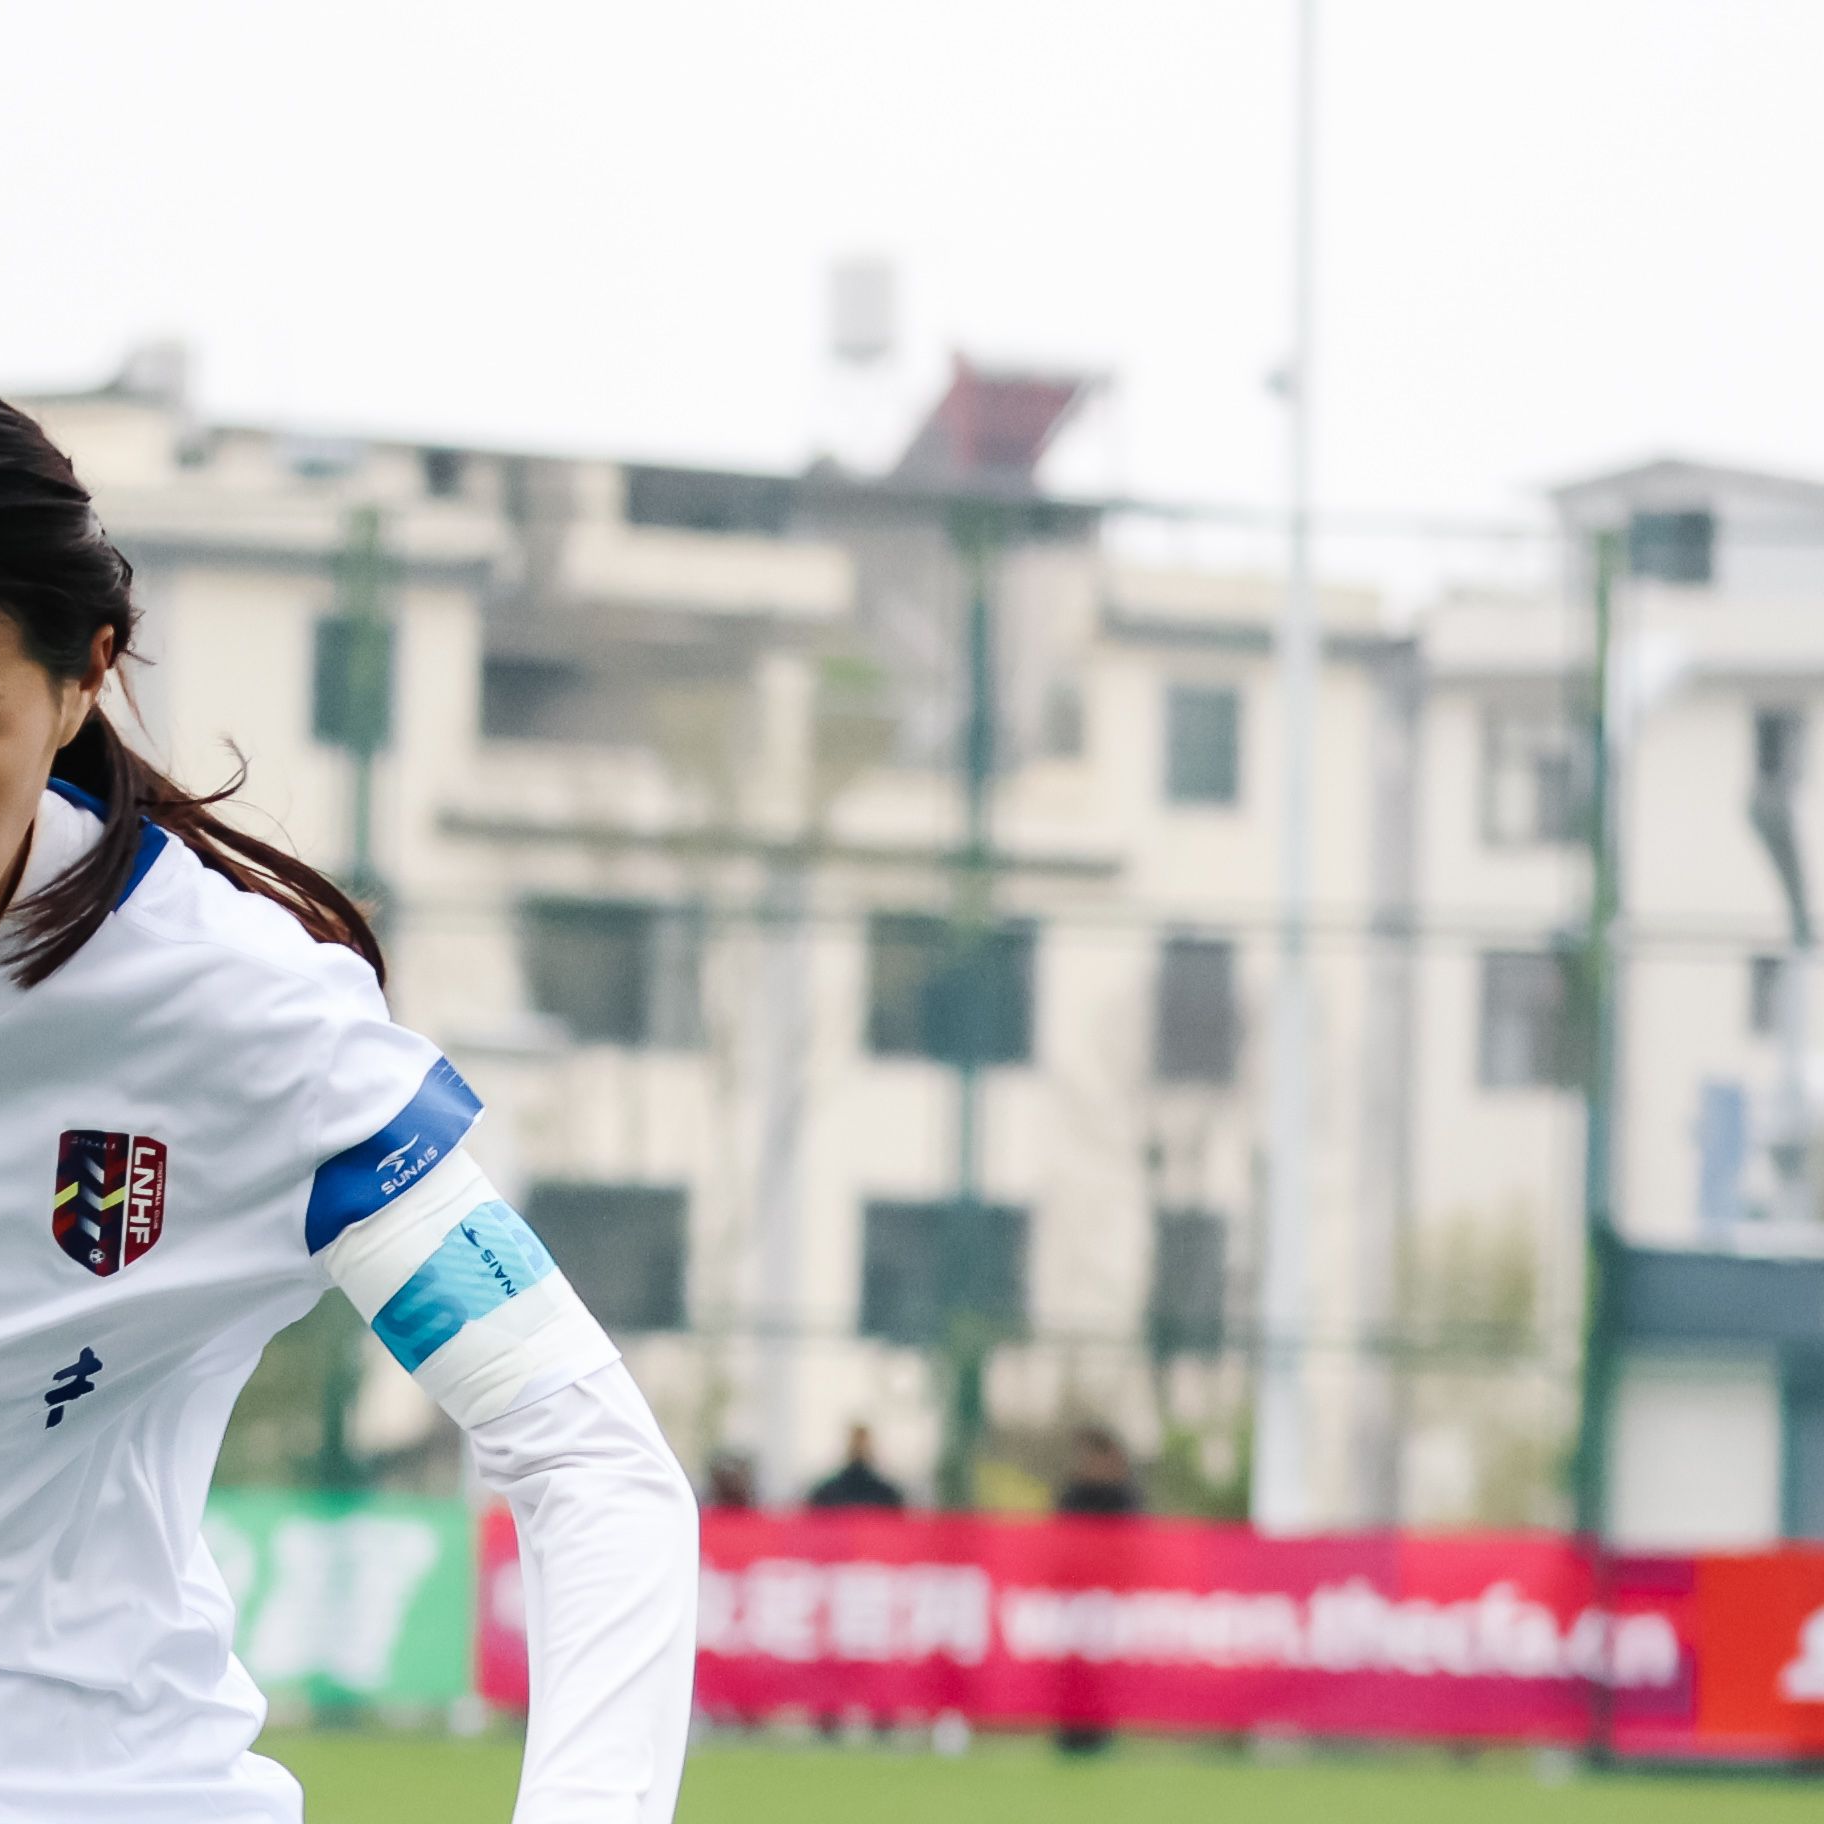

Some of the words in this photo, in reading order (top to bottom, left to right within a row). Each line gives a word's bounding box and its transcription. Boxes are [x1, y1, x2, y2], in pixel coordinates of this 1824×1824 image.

[129, 1146, 157, 1244] LNHF
[379, 1144, 440, 1197] SUNAIS
[479, 1248, 520, 1299] NAIS
